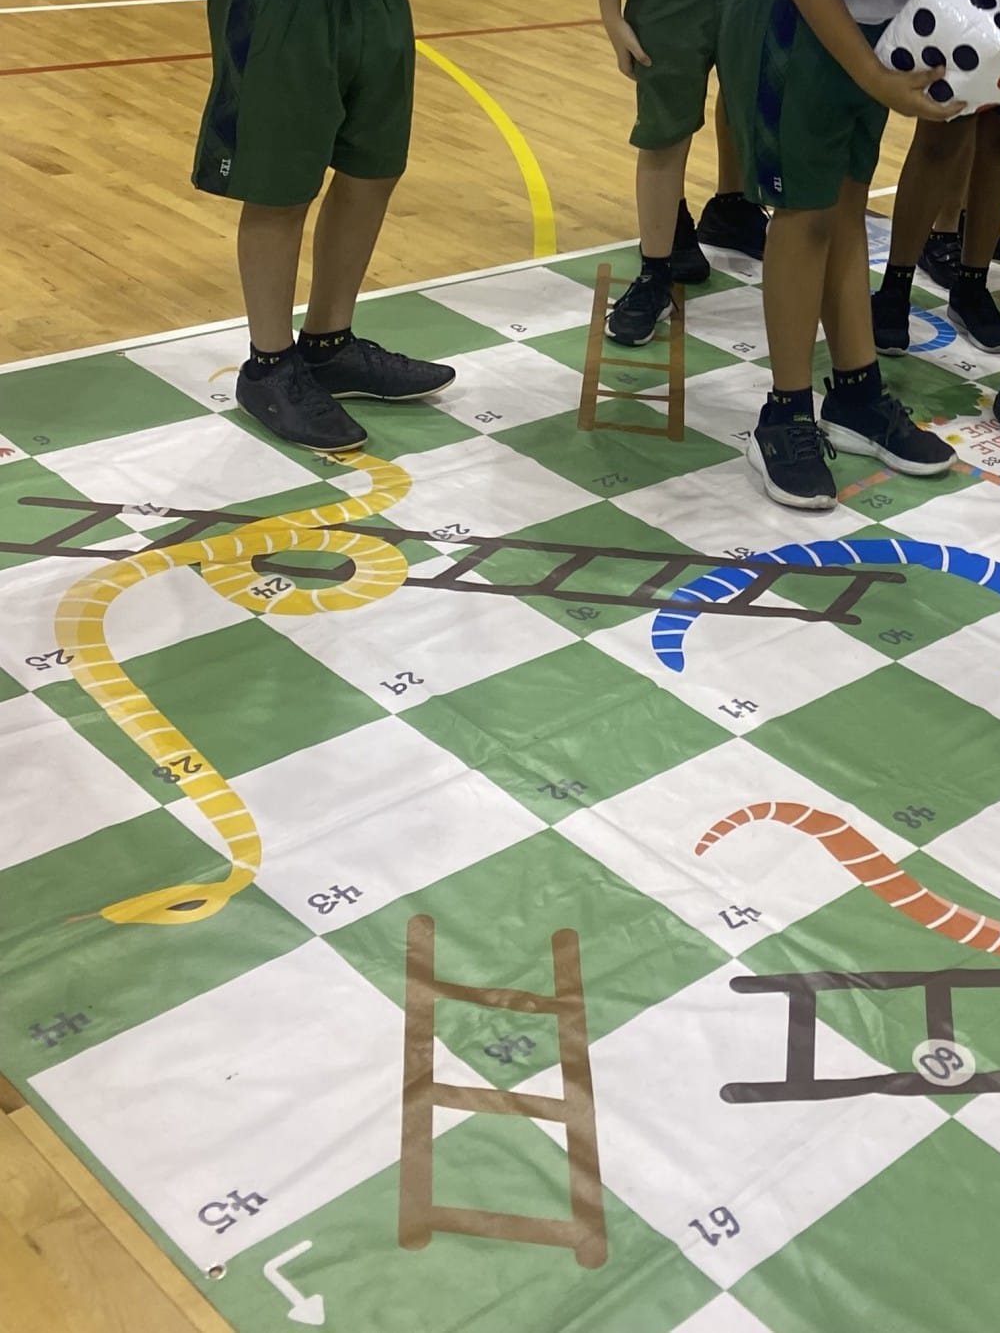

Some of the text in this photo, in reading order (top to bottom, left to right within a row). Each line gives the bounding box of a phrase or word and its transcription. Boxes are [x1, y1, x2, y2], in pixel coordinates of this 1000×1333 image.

[510, 323, 527, 333] 3
[732, 342, 756, 354] 15
[210, 393, 230, 403] 5
[475, 410, 503, 423] 13
[592, 471, 629, 488] 22
[133, 502, 164, 516] 11
[860, 493, 893, 509] 32
[432, 523, 470, 540] 23
[250, 576, 292, 599] 24
[565, 606, 602, 621] 30
[878, 628, 914, 645] 40
[25, 648, 75, 671] 25
[379, 671, 425, 695] 29
[718, 698, 760, 719] 41
[152, 755, 203, 785] 28
[891, 801, 937, 831] 48
[306, 882, 364, 916] 43
[716, 903, 763, 931] 47
[917, 1045, 964, 1081] 60
[197, 1188, 270, 1235] 45
[687, 1204, 742, 1248] 61
